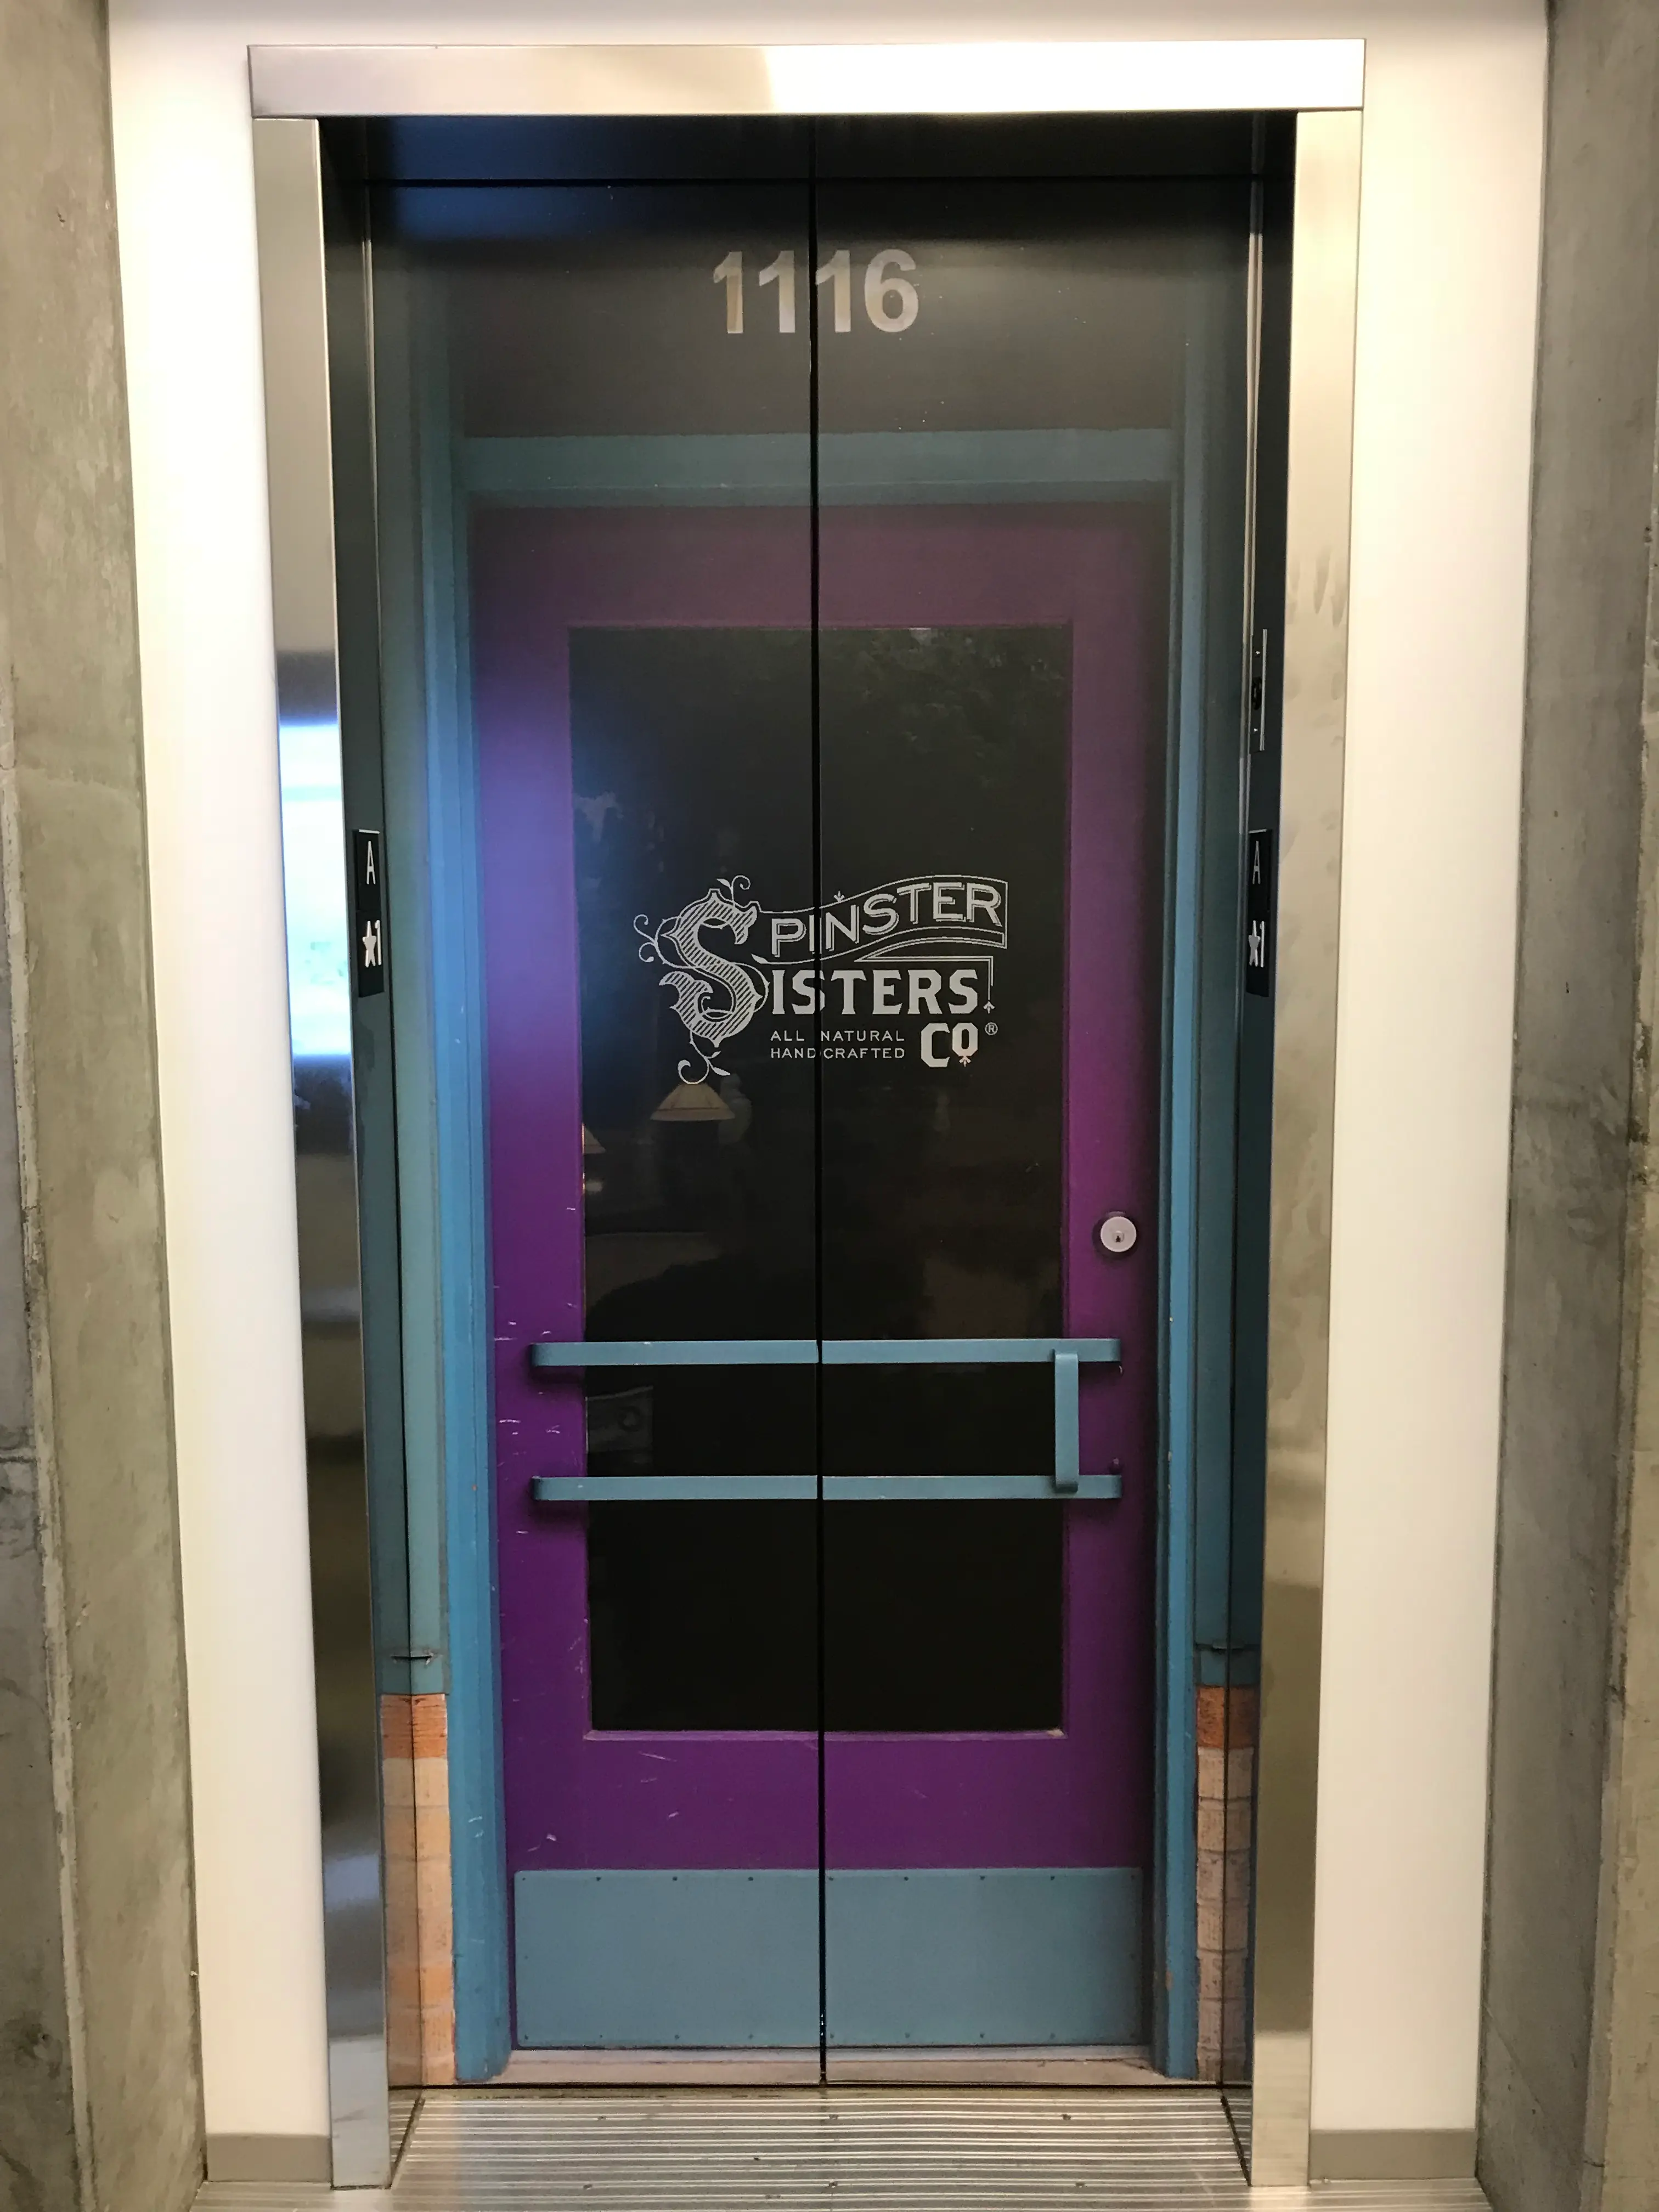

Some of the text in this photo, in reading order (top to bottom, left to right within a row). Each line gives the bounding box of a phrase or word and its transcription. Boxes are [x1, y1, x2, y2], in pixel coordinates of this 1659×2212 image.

[713, 249, 919, 334] 1116
[366, 840, 376, 885] A
[1252, 840, 1261, 885] A
[770, 1030, 905, 1041] ALL NATURAL
